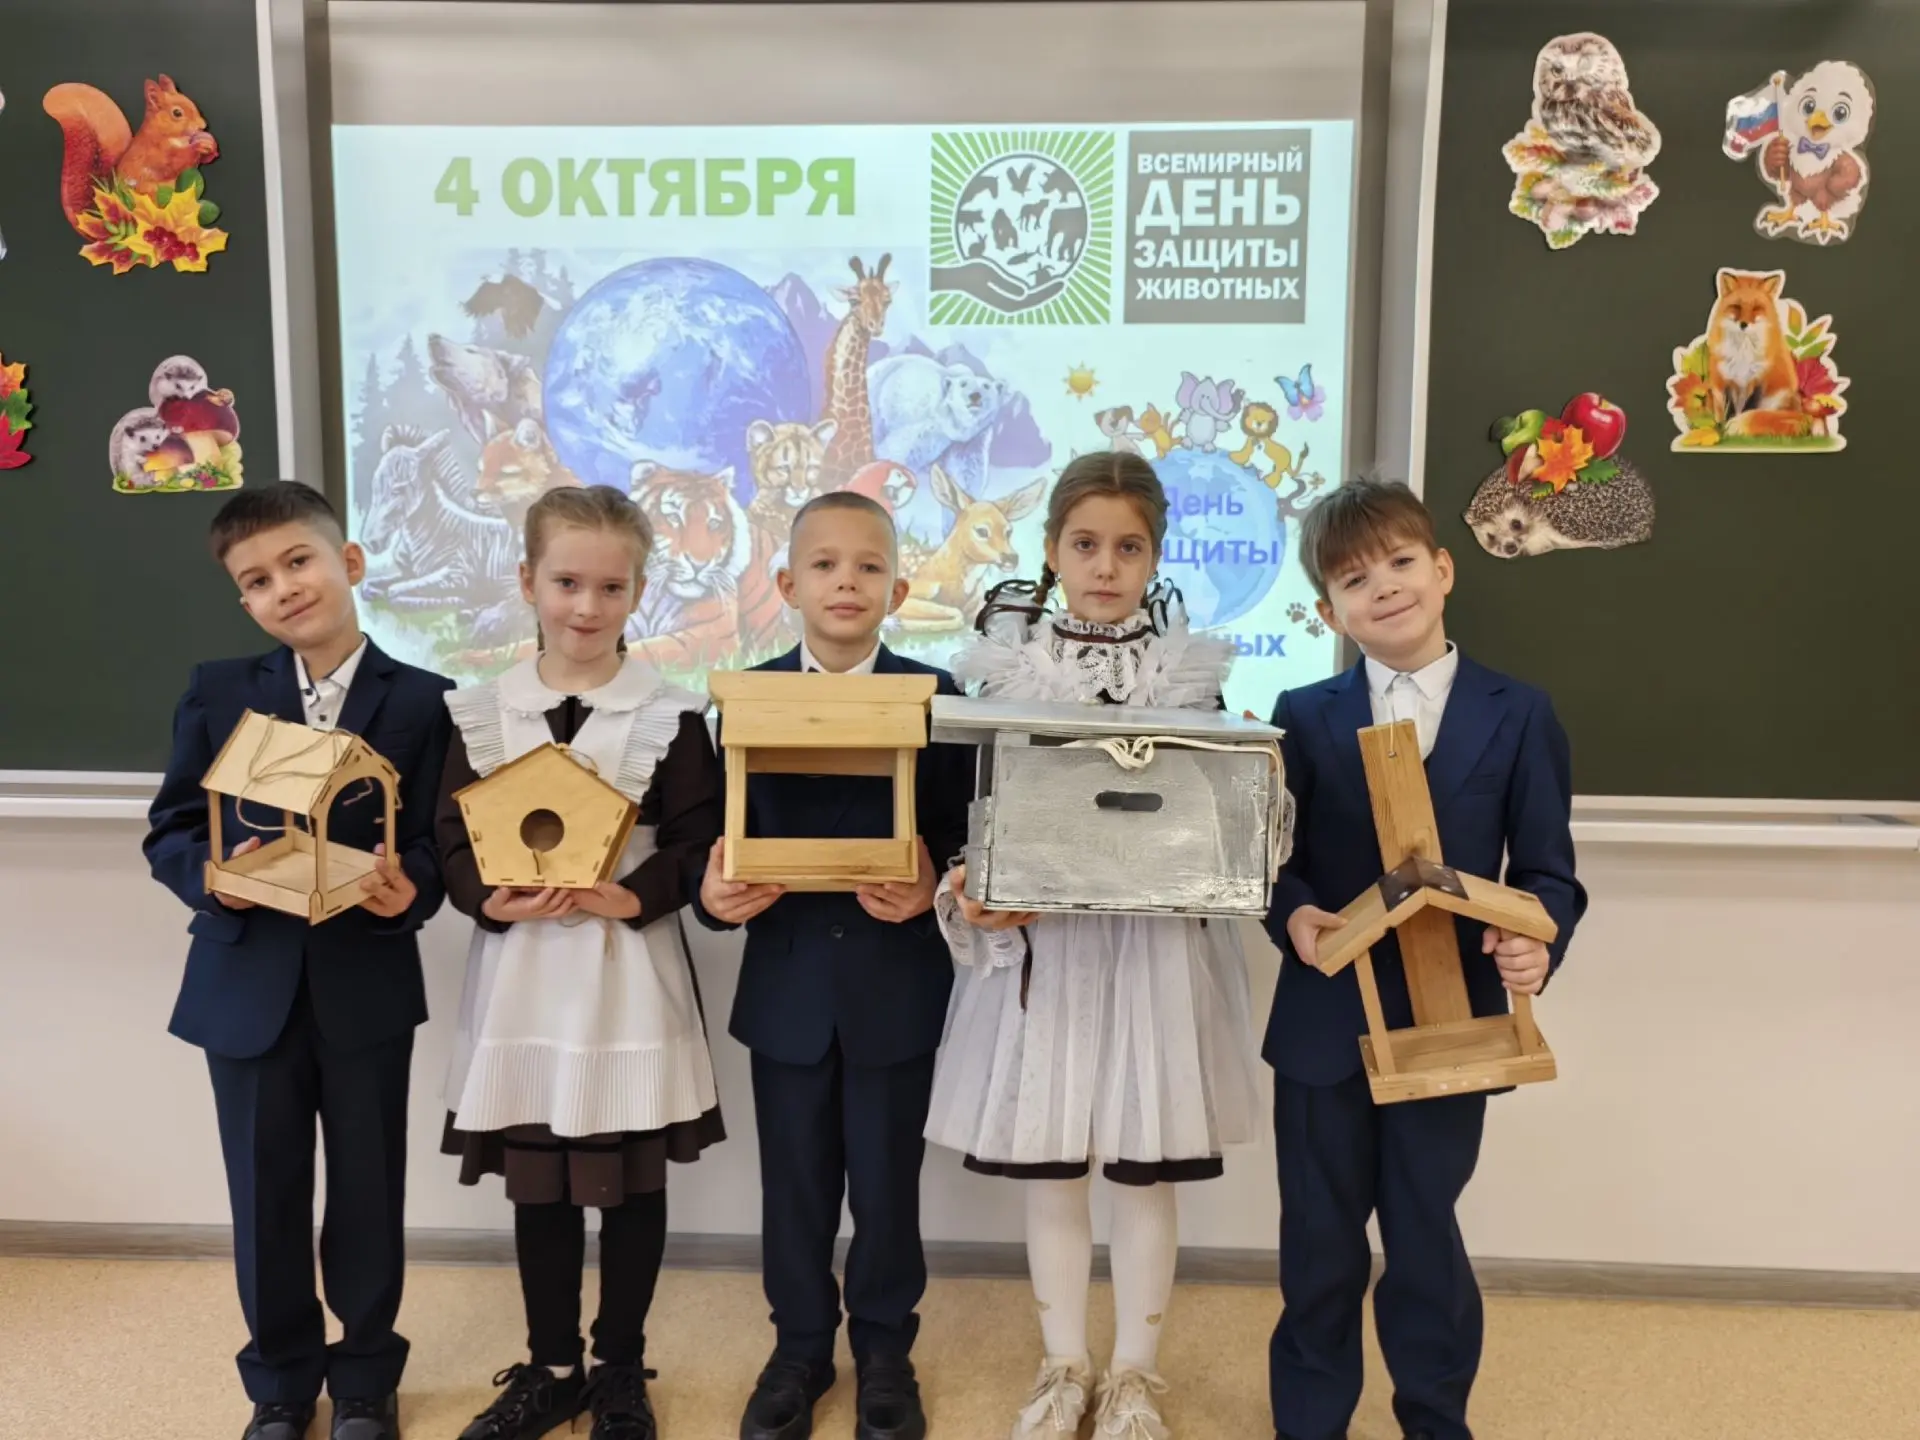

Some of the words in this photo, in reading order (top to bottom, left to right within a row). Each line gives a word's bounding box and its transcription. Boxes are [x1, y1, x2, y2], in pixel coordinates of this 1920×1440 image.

[1138, 145, 1303, 175] ВСЕМИРНЫЙ
[434, 156, 479, 217] 4
[501, 156, 856, 218] ОКТЯБРЯ
[1135, 178, 1301, 235] ДЕНЬ
[1134, 238, 1299, 273] ЗАЩИТЫ
[1136, 277, 1300, 300] ЖИВОТНЫХ
[1163, 539, 1278, 570] щиты
